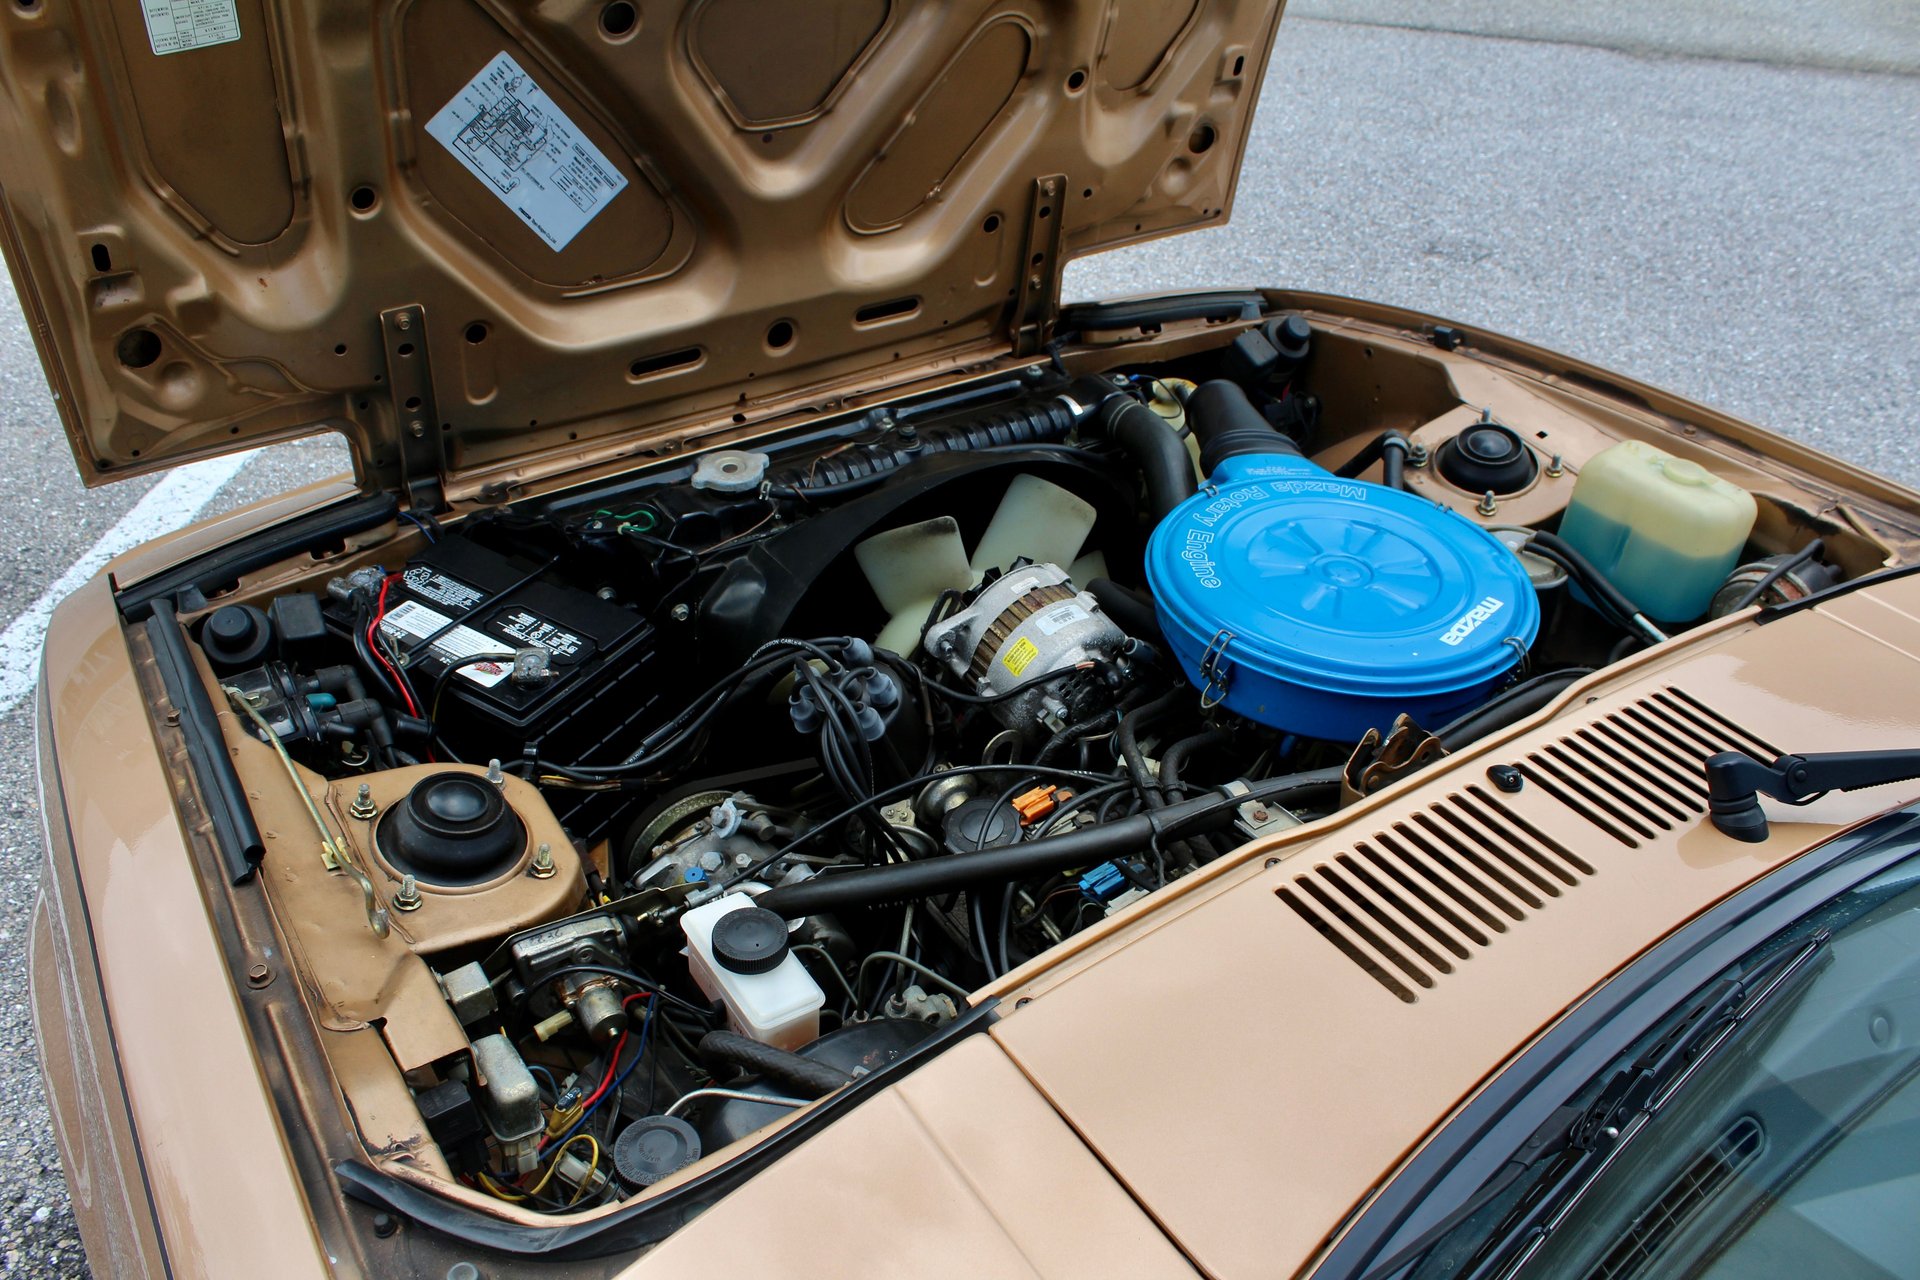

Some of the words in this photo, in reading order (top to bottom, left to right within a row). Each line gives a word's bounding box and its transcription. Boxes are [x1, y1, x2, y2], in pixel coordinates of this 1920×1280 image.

[1191, 484, 1265, 527] Rotary
[1270, 479, 1366, 501] Mazda
[1180, 528, 1222, 589] Engine
